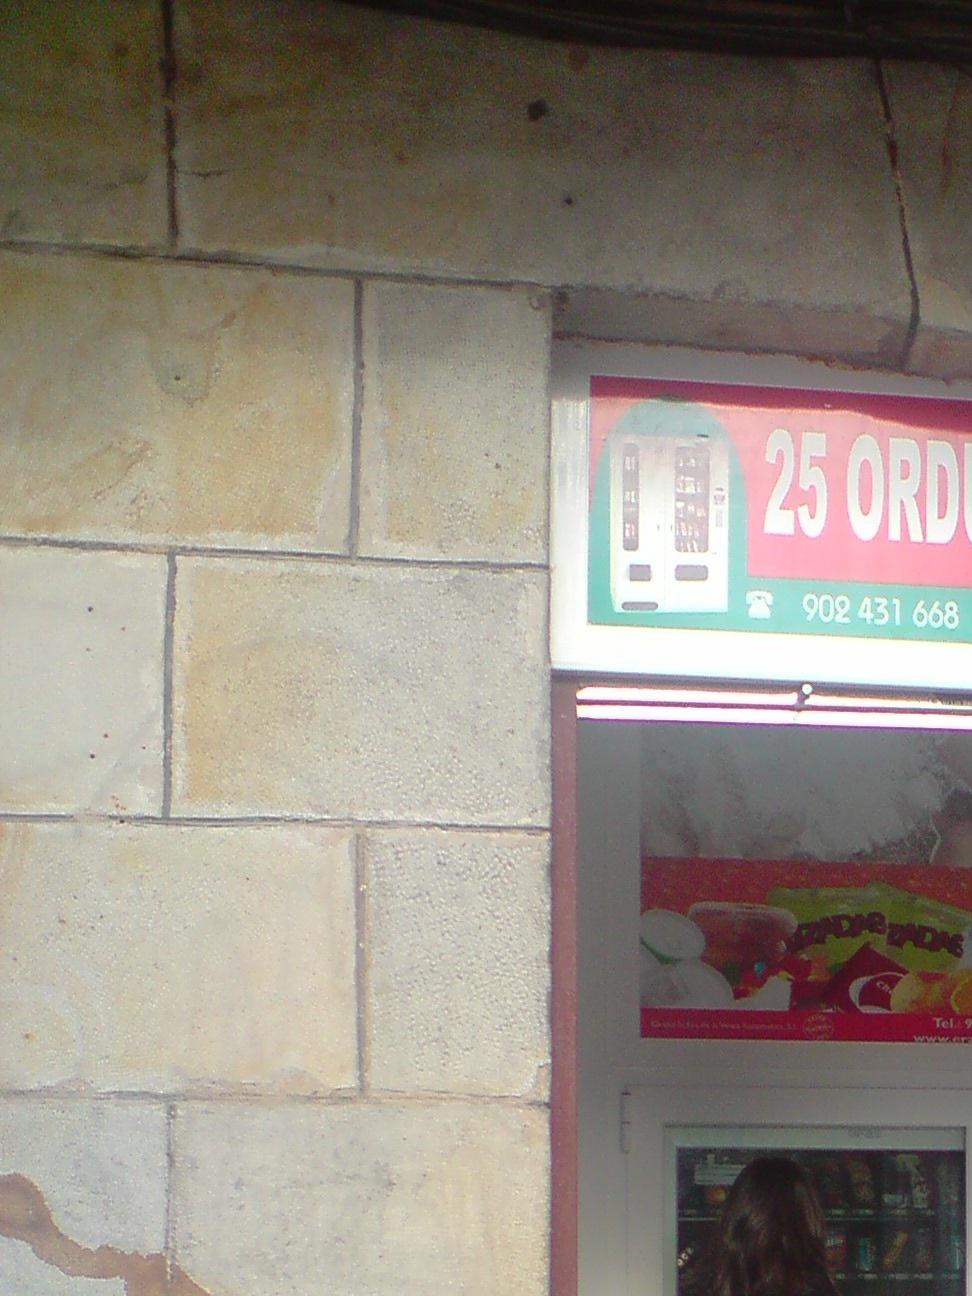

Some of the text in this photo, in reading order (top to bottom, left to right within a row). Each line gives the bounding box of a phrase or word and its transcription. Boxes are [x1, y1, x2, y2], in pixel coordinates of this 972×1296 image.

[763, 428, 829, 538] 25
[802, 593, 961, 630] 902 431 668
